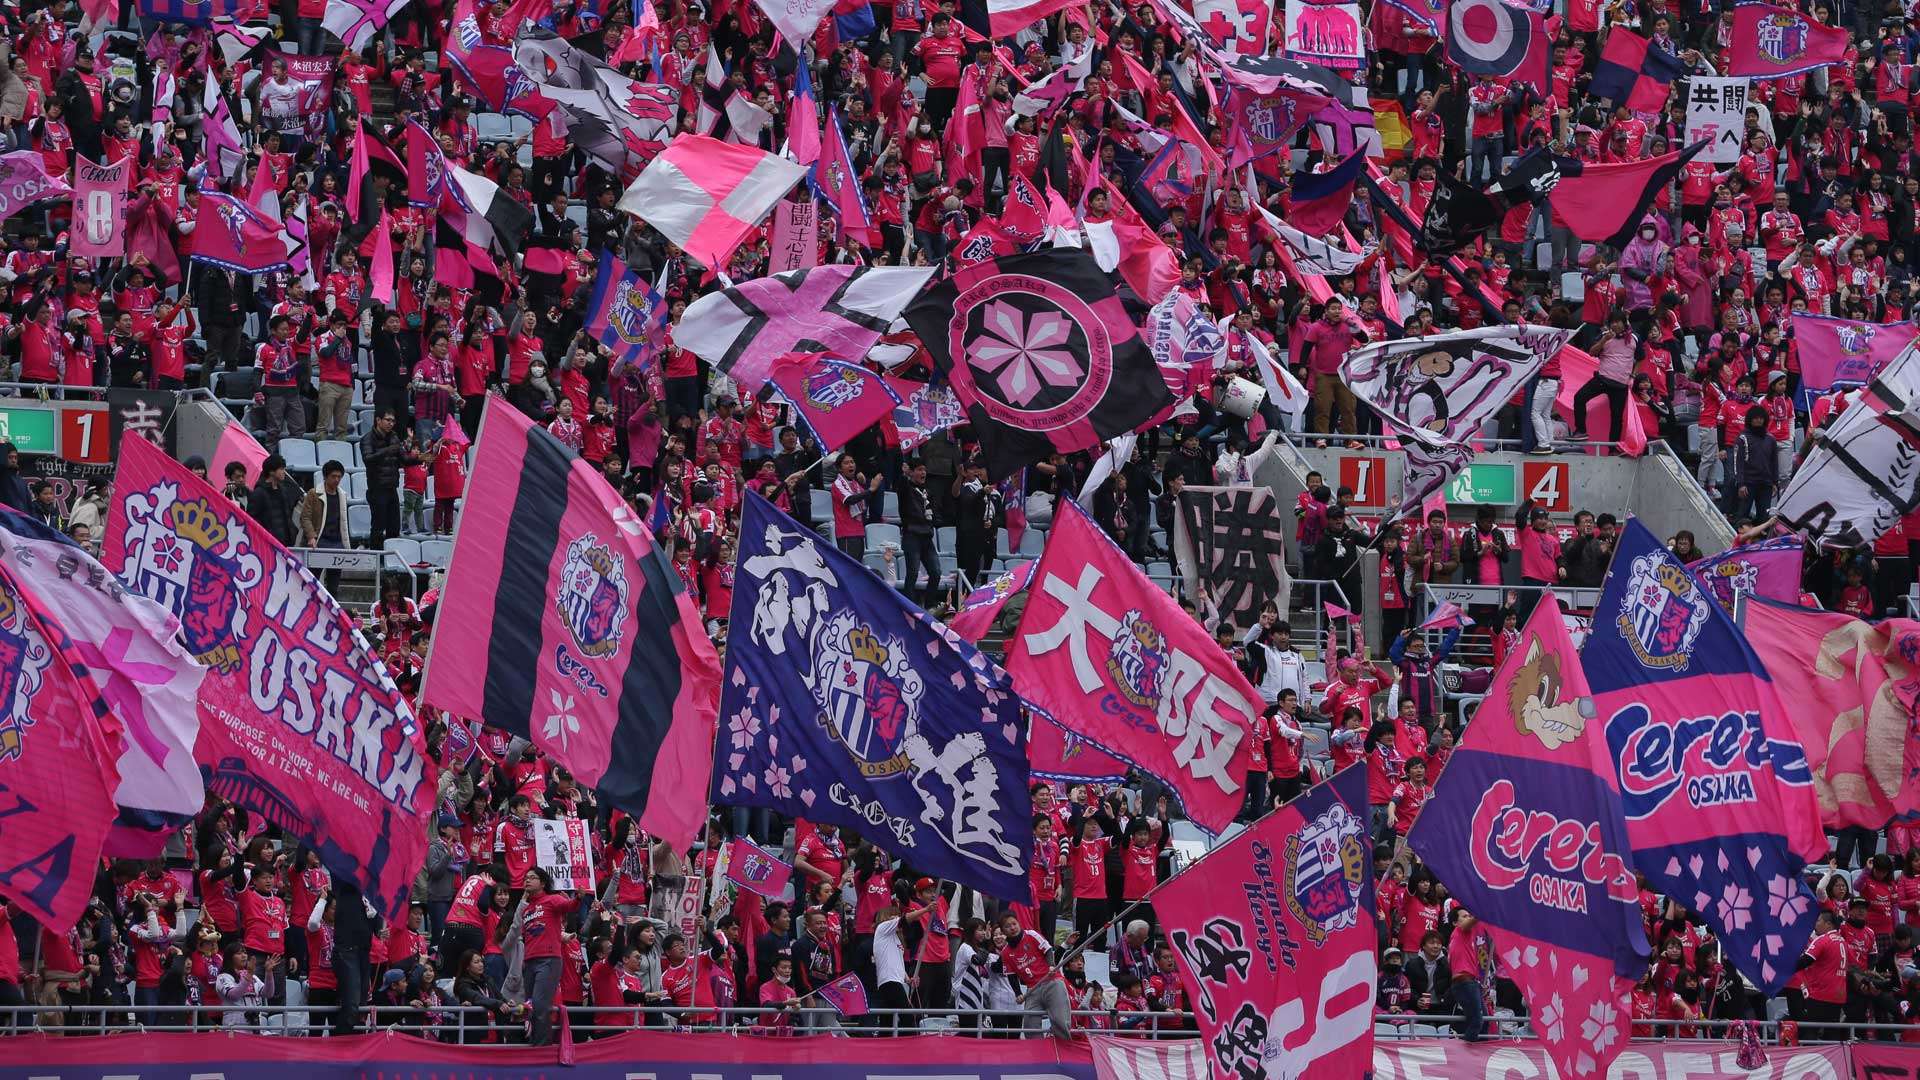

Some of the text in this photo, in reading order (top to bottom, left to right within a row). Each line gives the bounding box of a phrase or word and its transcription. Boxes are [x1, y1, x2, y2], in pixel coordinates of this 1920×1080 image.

[304, 80, 322, 110] 7
[1691, 84, 1746, 115] 共闘
[87, 190, 113, 245] 8
[988, 278, 1048, 294] OSAKA
[76, 413, 93, 458] 1
[1354, 460, 1370, 502] I
[1531, 465, 1559, 507] 4
[331, 556, 360, 566] Iゾーン
[1179, 488, 1284, 627] 勝
[1445, 590, 1475, 600] Jゾーン
[556, 643, 608, 698] Cerezo
[1024, 562, 1257, 796] 大阪
[1647, 655, 1678, 665] OSAKA
[250, 627, 425, 814] OSAKA
[268, 752, 277, 767] A
[317, 769, 331, 789] WE
[331, 776, 352, 801] ARE
[353, 793, 373, 816] ONE.
[1687, 771, 1754, 808] OSAKA
[1530, 872, 1587, 914] OSAKA
[1839, 943, 1846, 969] 9
